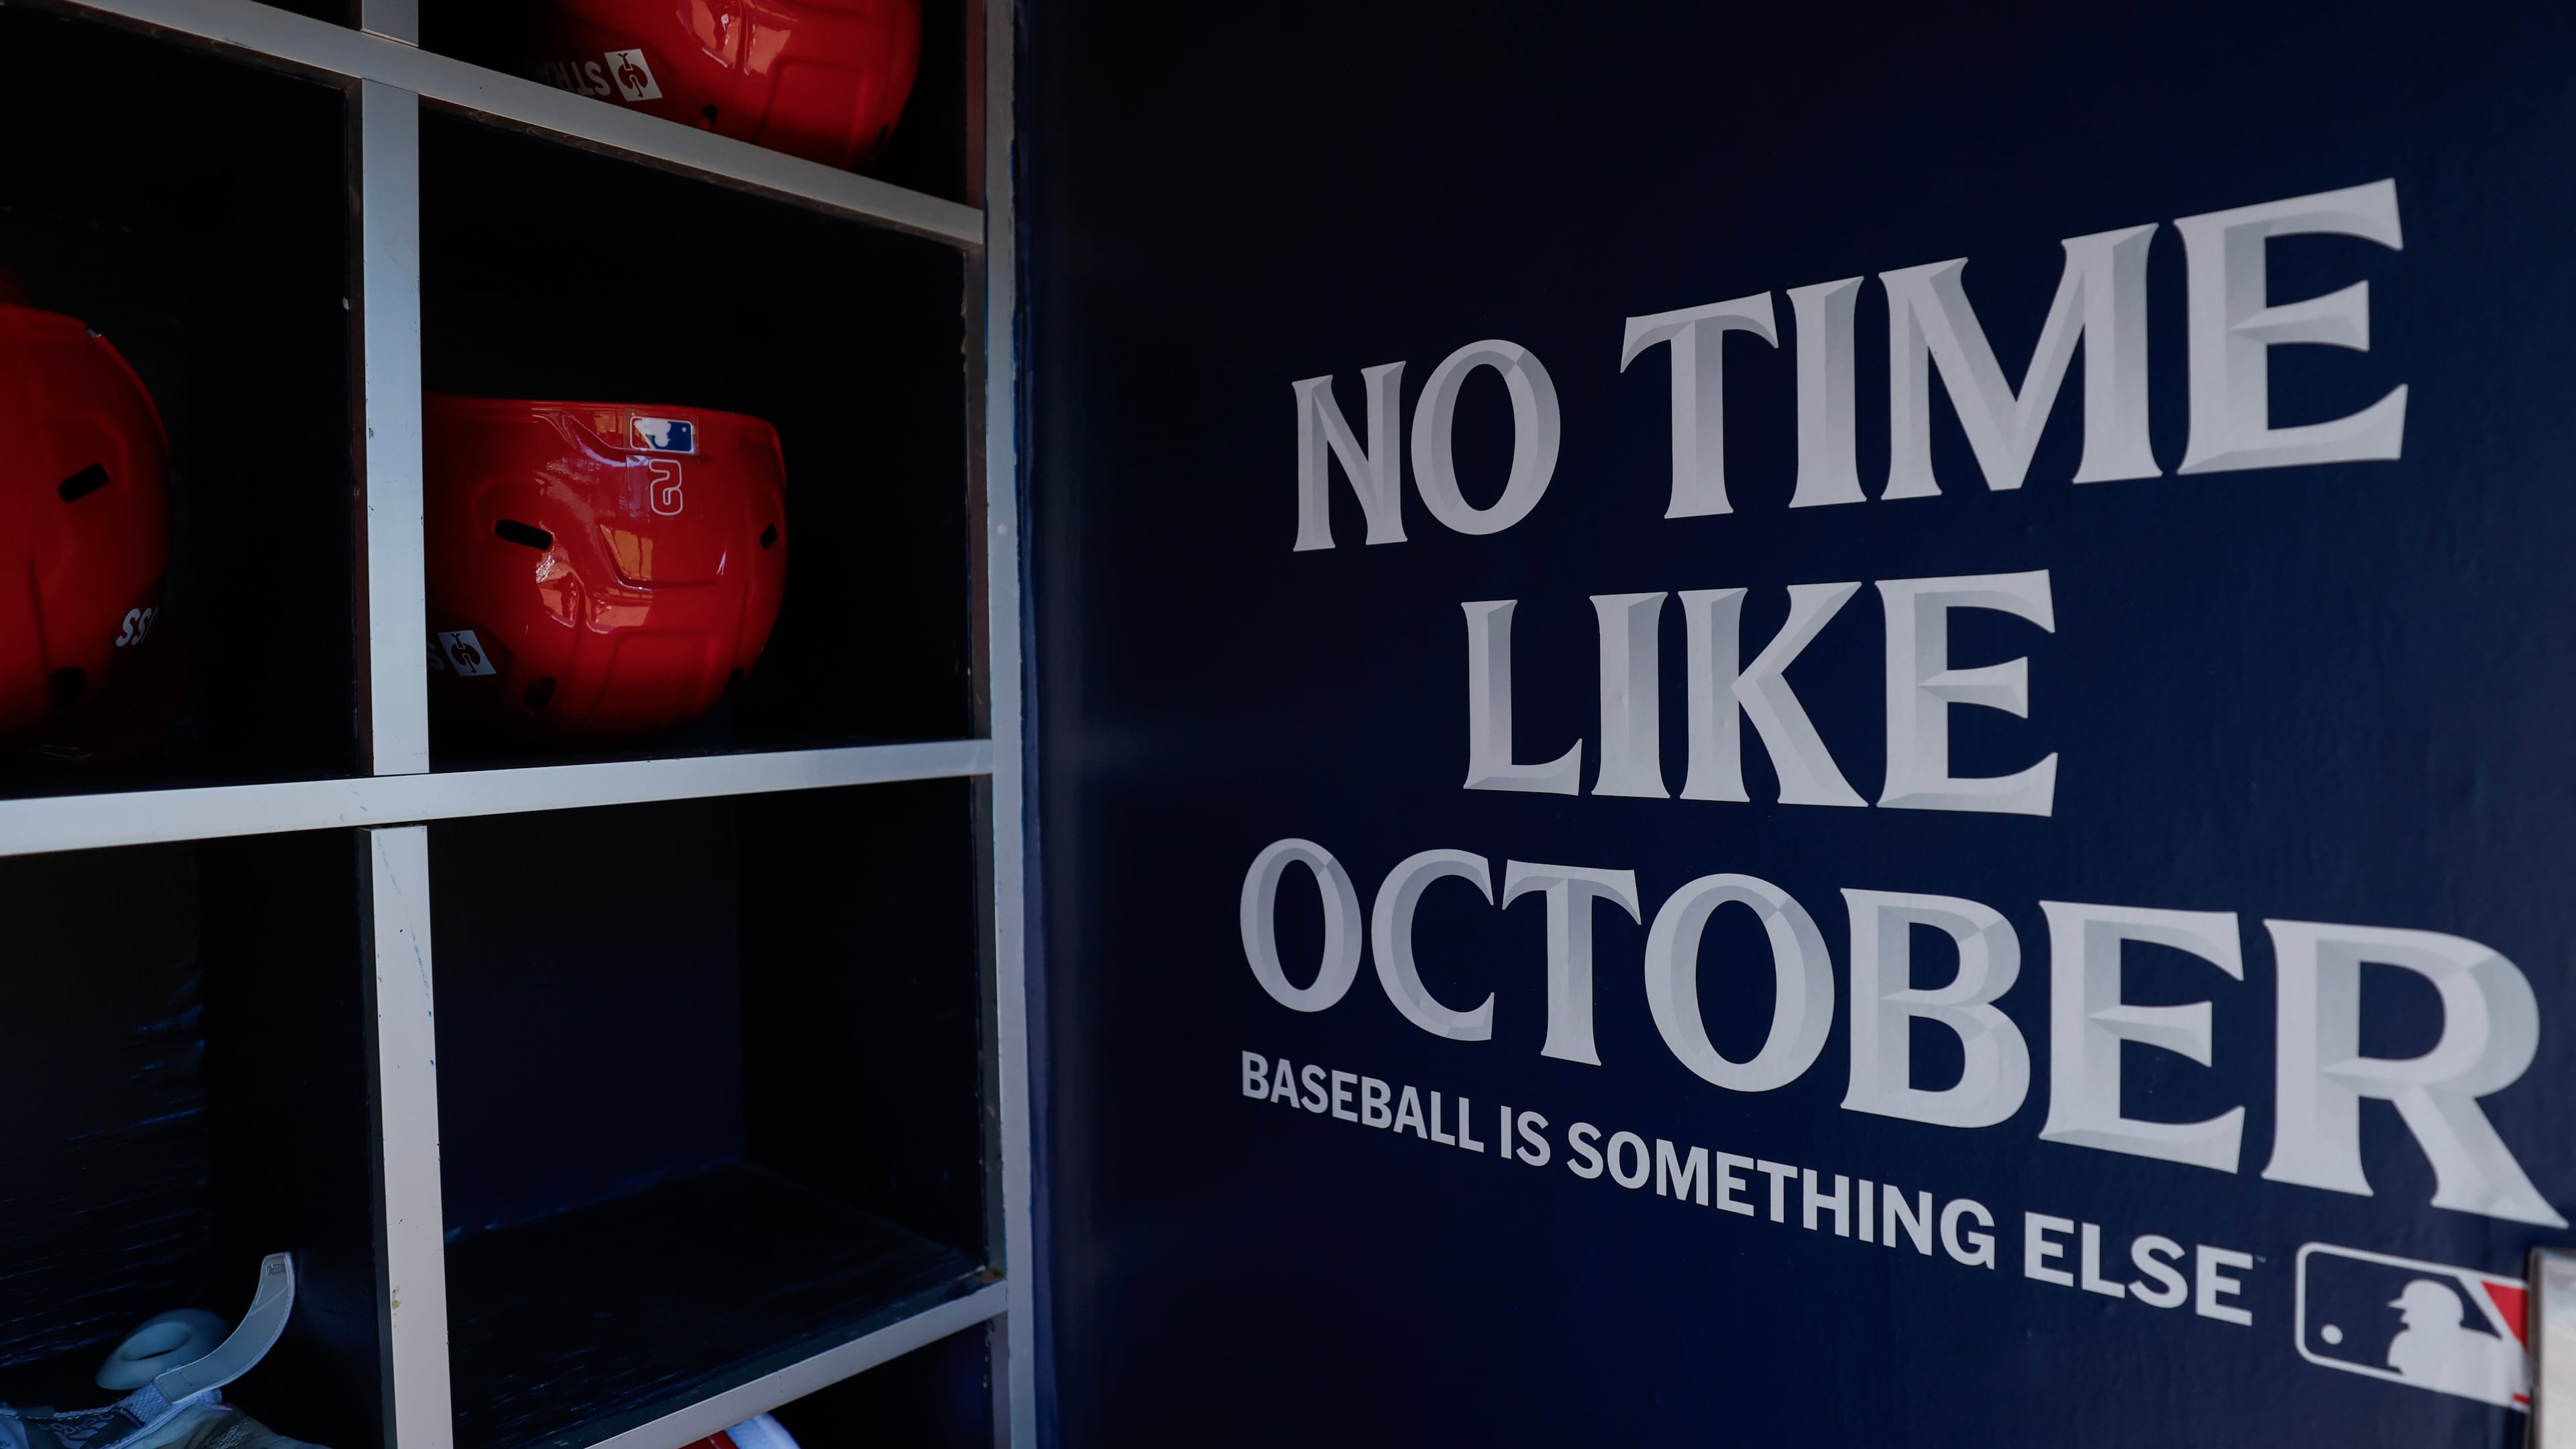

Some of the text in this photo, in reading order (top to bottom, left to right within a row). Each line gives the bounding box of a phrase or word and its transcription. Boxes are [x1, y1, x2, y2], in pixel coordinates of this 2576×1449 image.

[649, 459, 683, 515] 2
[1292, 179, 2408, 551] NO TIME
[1461, 570, 2057, 816] LIKE
[1240, 839, 2568, 1228] OCTOBER
[1243, 1051, 1484, 1152] BASEBALL
[1501, 1106, 1550, 1166] IS
[1567, 1122, 1994, 1269] SOMETHING
[2025, 1212, 2253, 1326] ELSE
